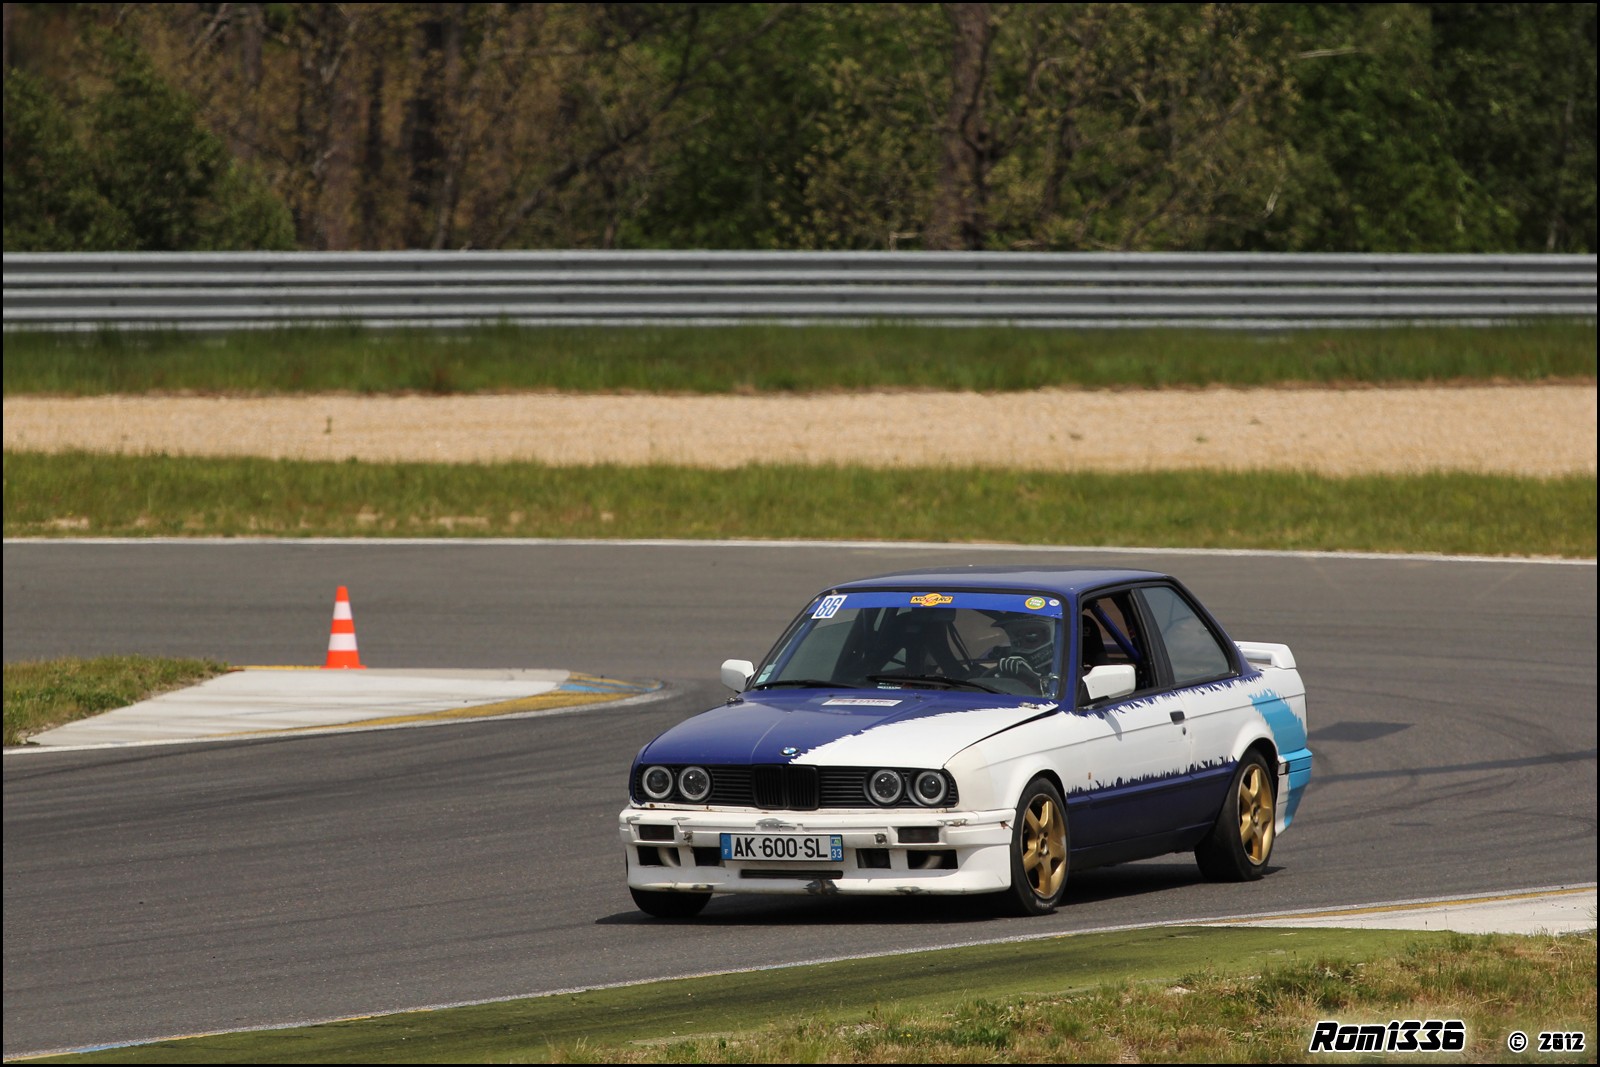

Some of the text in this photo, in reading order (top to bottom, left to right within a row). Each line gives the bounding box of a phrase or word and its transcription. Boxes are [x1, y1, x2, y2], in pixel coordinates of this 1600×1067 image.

[815, 597, 843, 617] 86
[733, 837, 828, 858] AK-600-SL
[831, 848, 842, 859] 33
